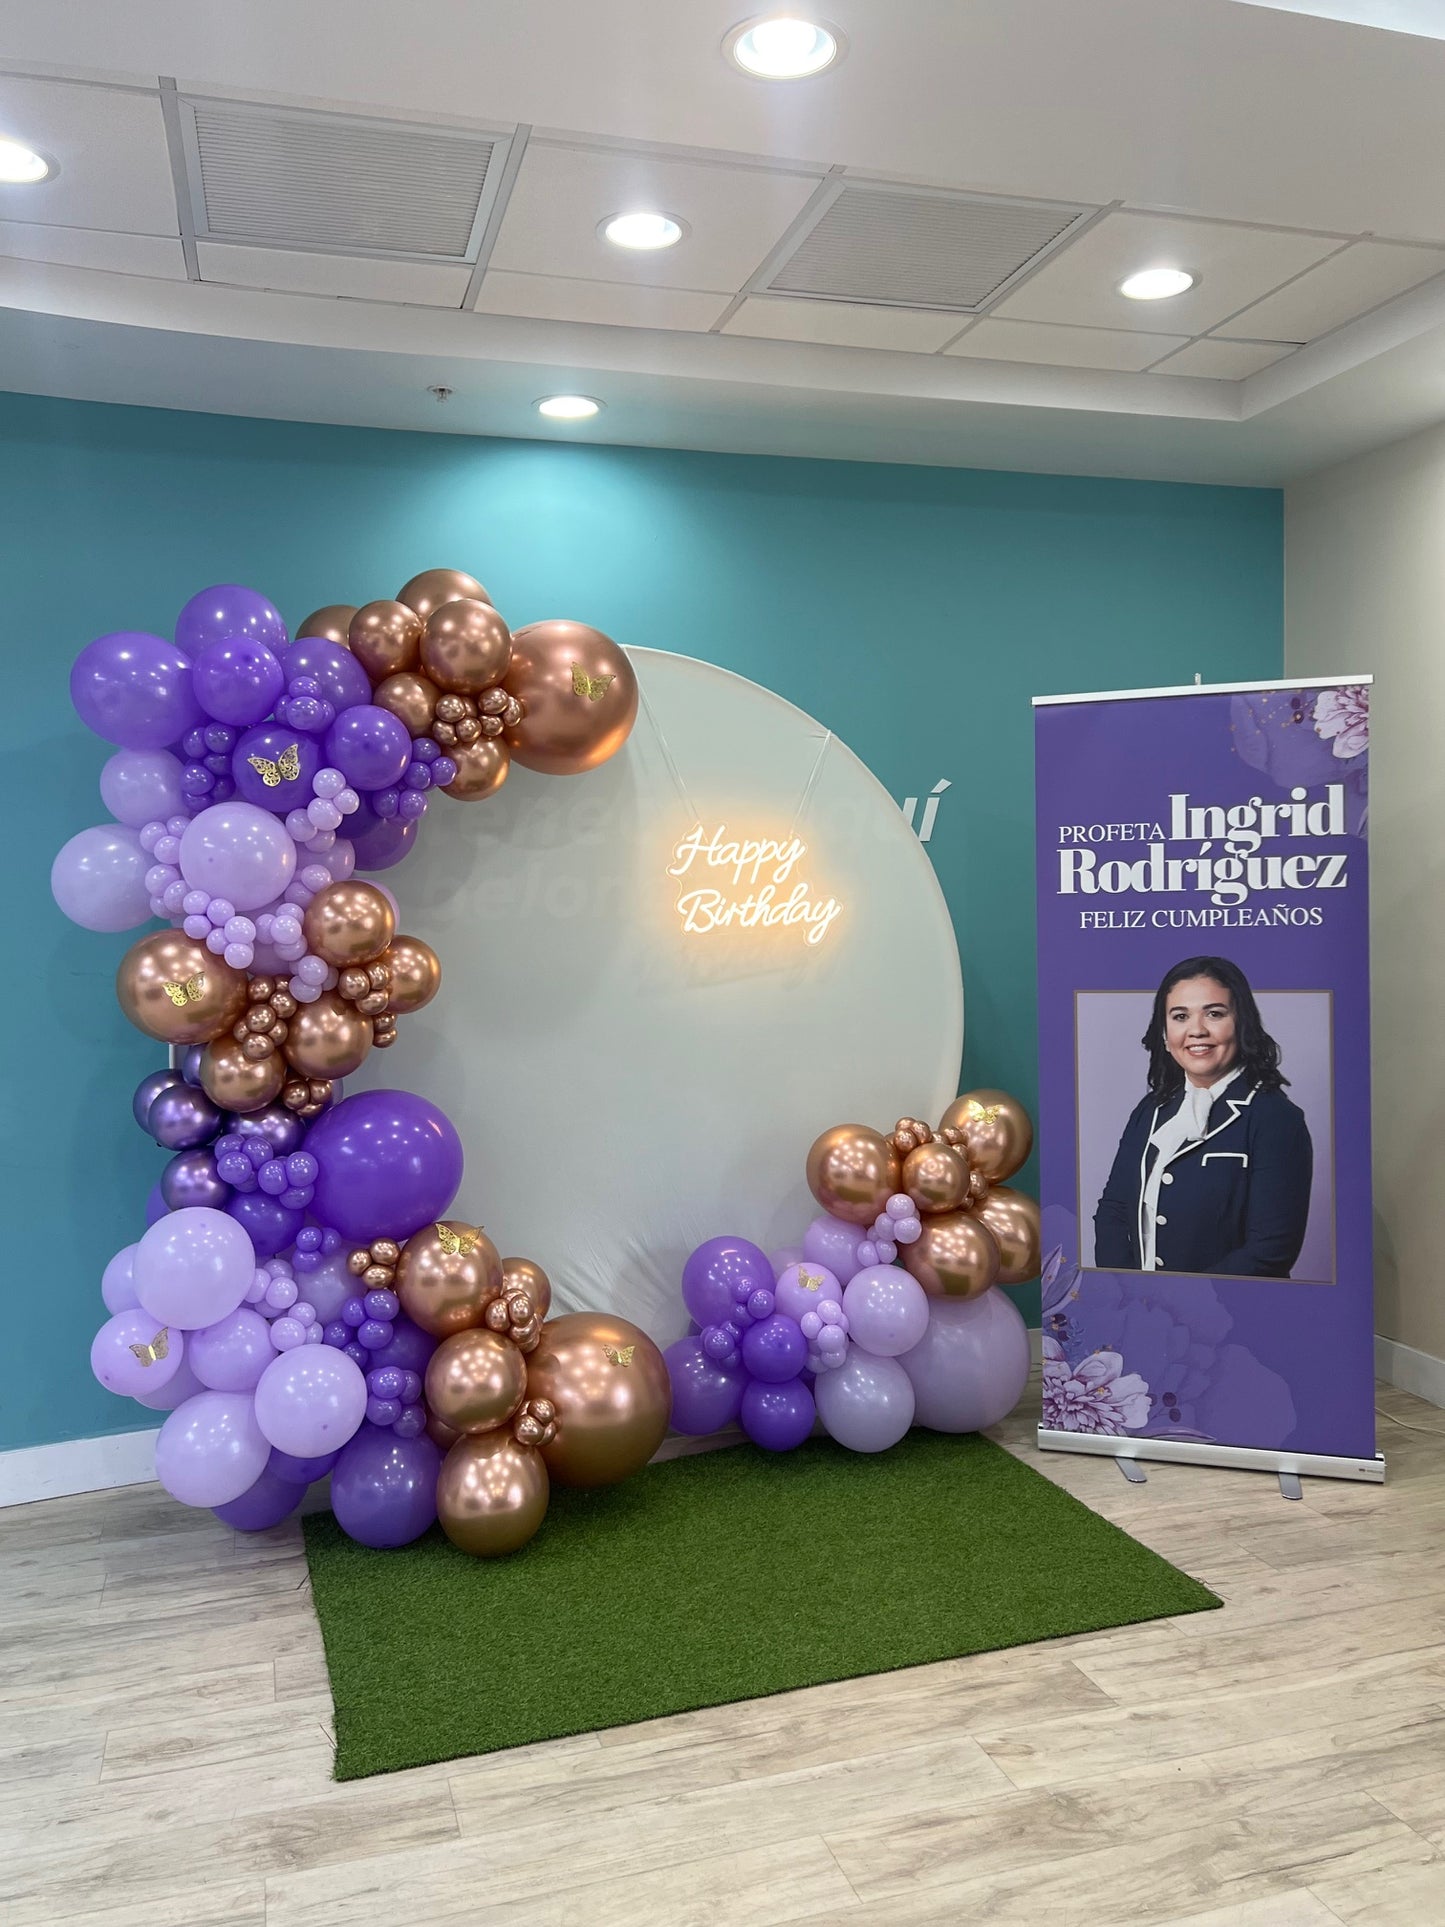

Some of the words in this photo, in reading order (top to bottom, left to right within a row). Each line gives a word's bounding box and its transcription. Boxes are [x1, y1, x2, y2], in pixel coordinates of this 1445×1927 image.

[1058, 822, 1166, 843] PROFETA
[1168, 784, 1348, 854] Ingrid
[669, 824, 806, 886] Happy
[1056, 841, 1348, 907] Rodríguez
[677, 883, 842, 944] Birthday
[1079, 909, 1146, 930] FELIZ
[1151, 903, 1323, 929] CUMPLEAÑOS
